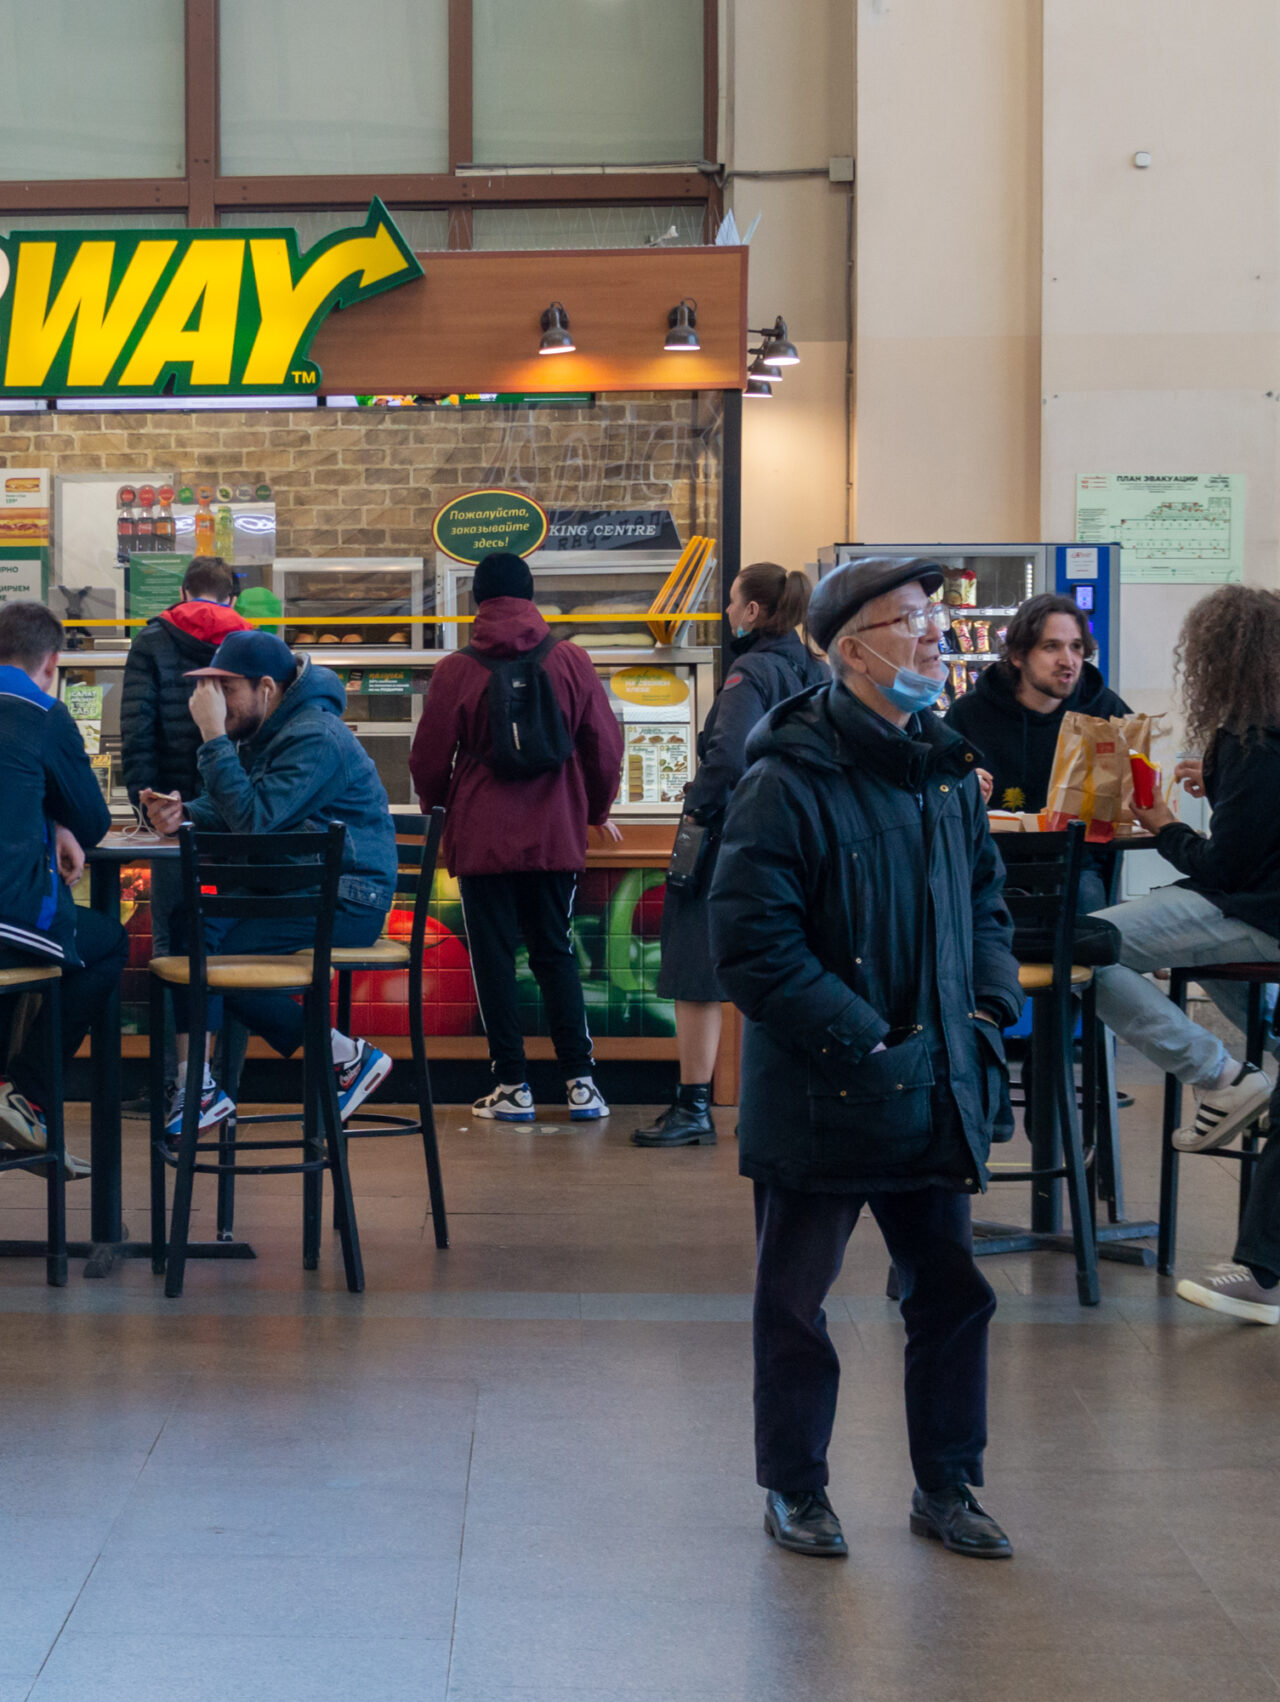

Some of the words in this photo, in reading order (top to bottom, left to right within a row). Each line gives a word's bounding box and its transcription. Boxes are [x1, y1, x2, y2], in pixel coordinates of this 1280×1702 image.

[291, 372, 317, 385] TM
[449, 507, 530, 521] Пожалуйста,
[451, 522, 530, 536] заказывайте
[593, 524, 657, 536] CENTRE
[473, 537, 510, 549] здесь!
